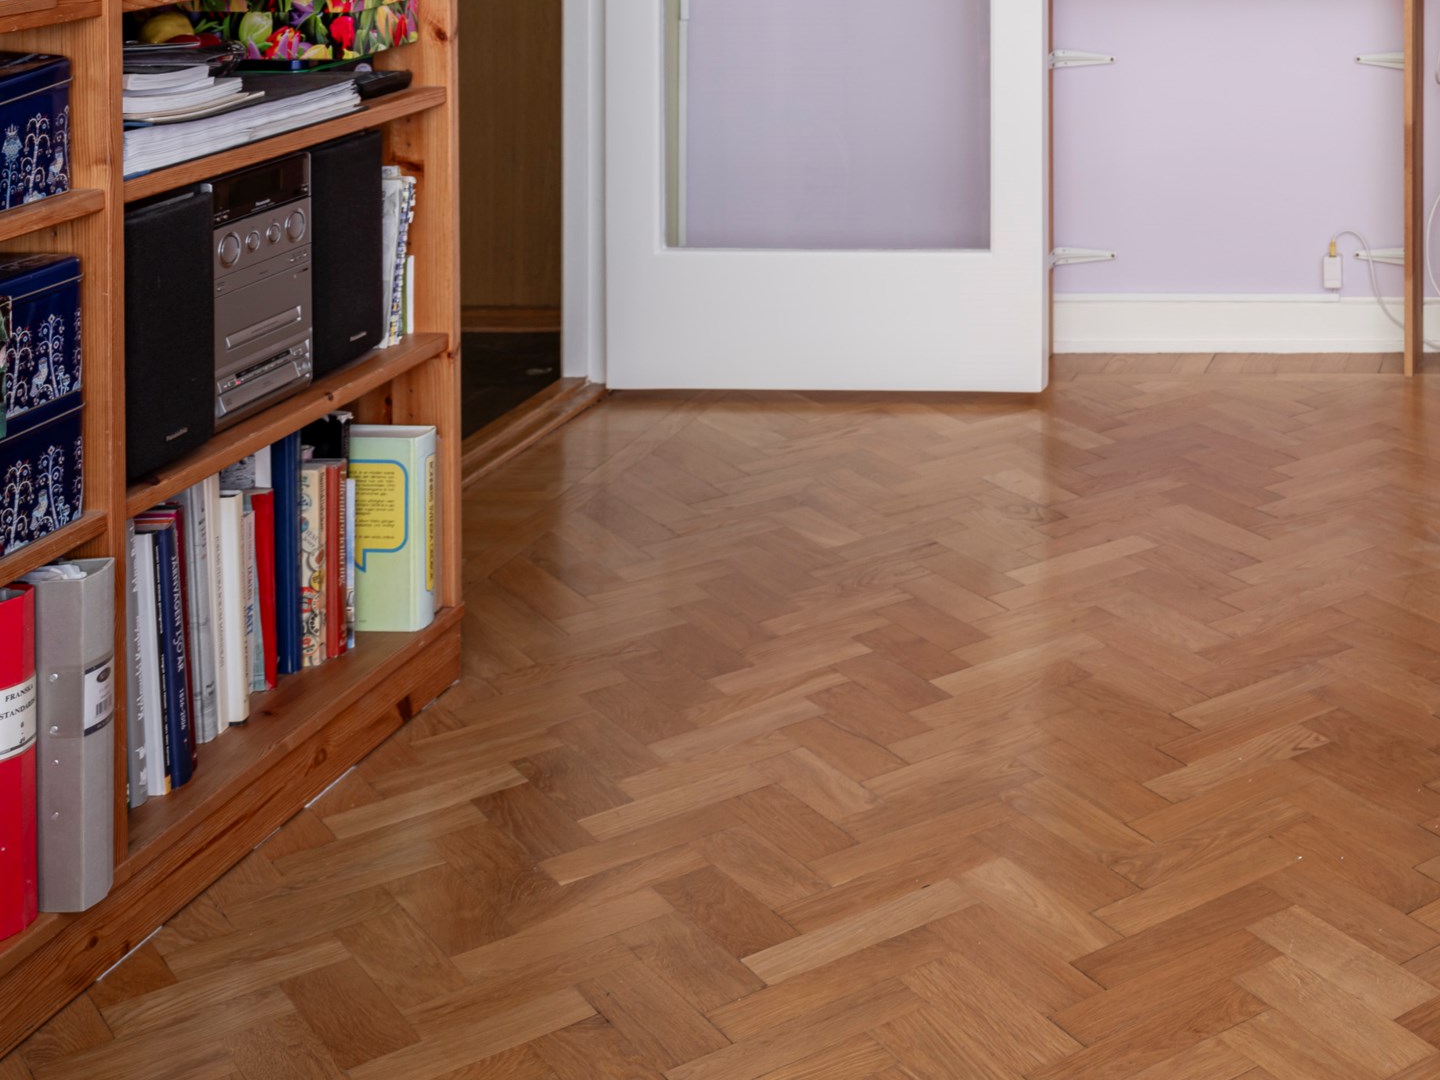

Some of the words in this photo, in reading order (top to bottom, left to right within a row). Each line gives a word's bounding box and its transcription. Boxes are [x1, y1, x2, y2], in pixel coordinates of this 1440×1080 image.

[171, 556, 182, 626] JÄRNVÄGEN
[246, 604, 254, 636] KATT
[172, 630, 182, 652] 150
[177, 656, 184, 672] ÅR
[5, 684, 33, 702] FRANSKA
